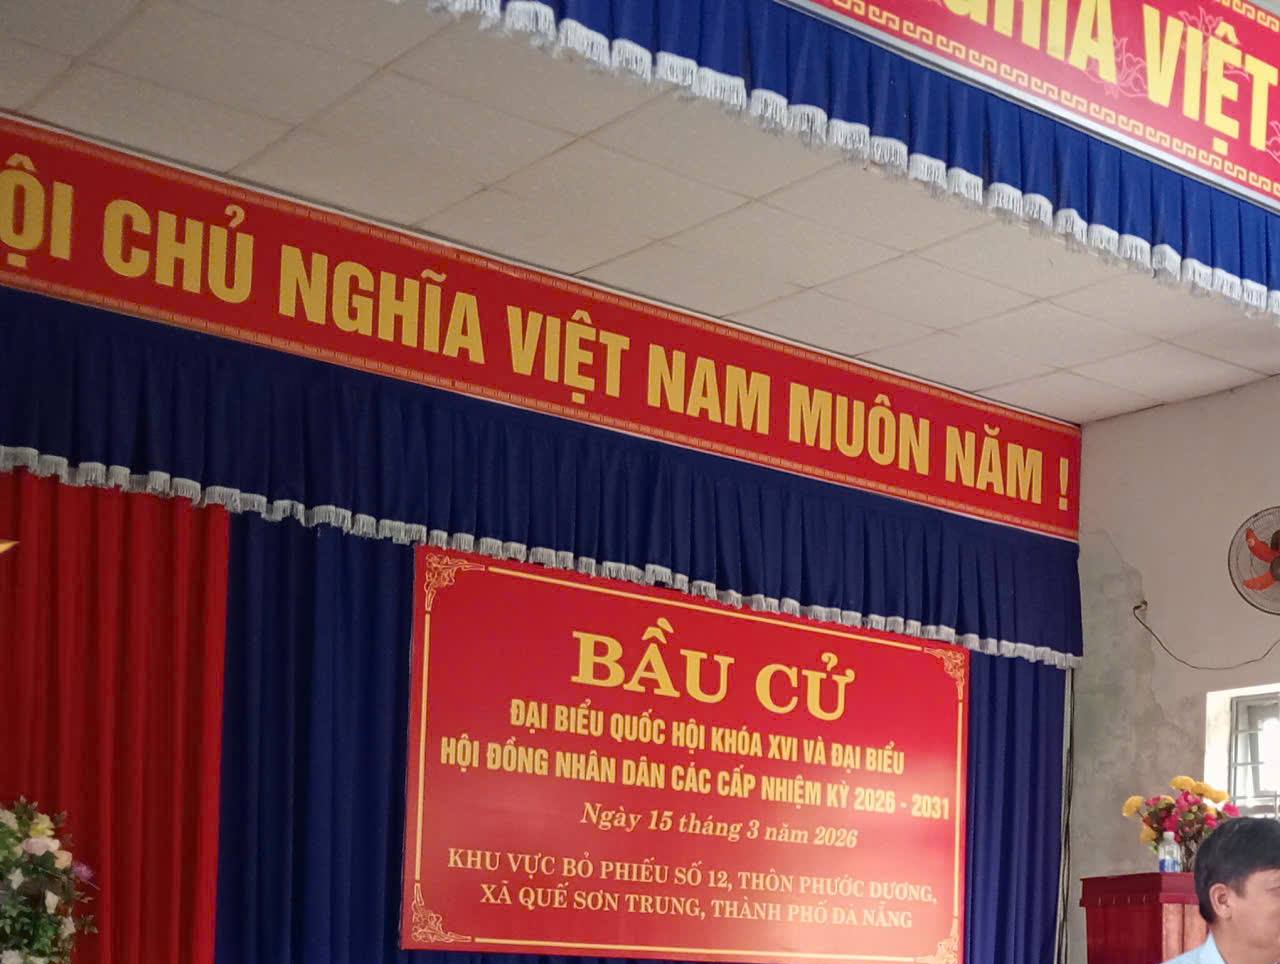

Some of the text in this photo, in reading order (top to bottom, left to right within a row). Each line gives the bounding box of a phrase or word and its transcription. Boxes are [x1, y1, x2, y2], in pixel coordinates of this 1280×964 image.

[1143, 3, 1279, 157] VIỆT
[103, 204, 254, 304] CHỦ
[278, 244, 485, 364] NGHĨA
[507, 304, 630, 404] VIỆT
[647, 343, 771, 436] NAM
[788, 383, 930, 476] MUÔN
[945, 423, 1042, 504] NĂM
[1059, 457, 1070, 511] !
[571, 617, 856, 721] BẦU CỬ
[440, 733, 479, 772] HỘI
[486, 736, 548, 775] ĐỒNG
[555, 750, 616, 784] NHÂN
[622, 756, 665, 789] DÂN
[671, 762, 711, 794] CÁC
[717, 764, 756, 798] CẤP
[762, 775, 821, 809] NHIỆM
[827, 781, 849, 808] KỲ
[854, 787, 896, 814] 2026
[912, 794, 949, 821] 2031
[510, 698, 905, 775] ĐẠI BIỂU QUỐC HỘI KHÓA XVI VÀ ĐẠI BIỂU
[580, 802, 858, 848] Ngày 15 tháng 3 năm 2026
[448, 848, 937, 904] KHU VỰC BỎ PHIẾU SỐ 12, THÔN PHƯỚC DƯƠNG,
[480, 880, 512, 904] XÃ
[518, 882, 568, 910] QUẾ
[573, 889, 619, 912] SƠN
[625, 894, 706, 920] TRUNG,
[711, 896, 781, 921] THÀNH
[788, 900, 829, 924] PHỐ
